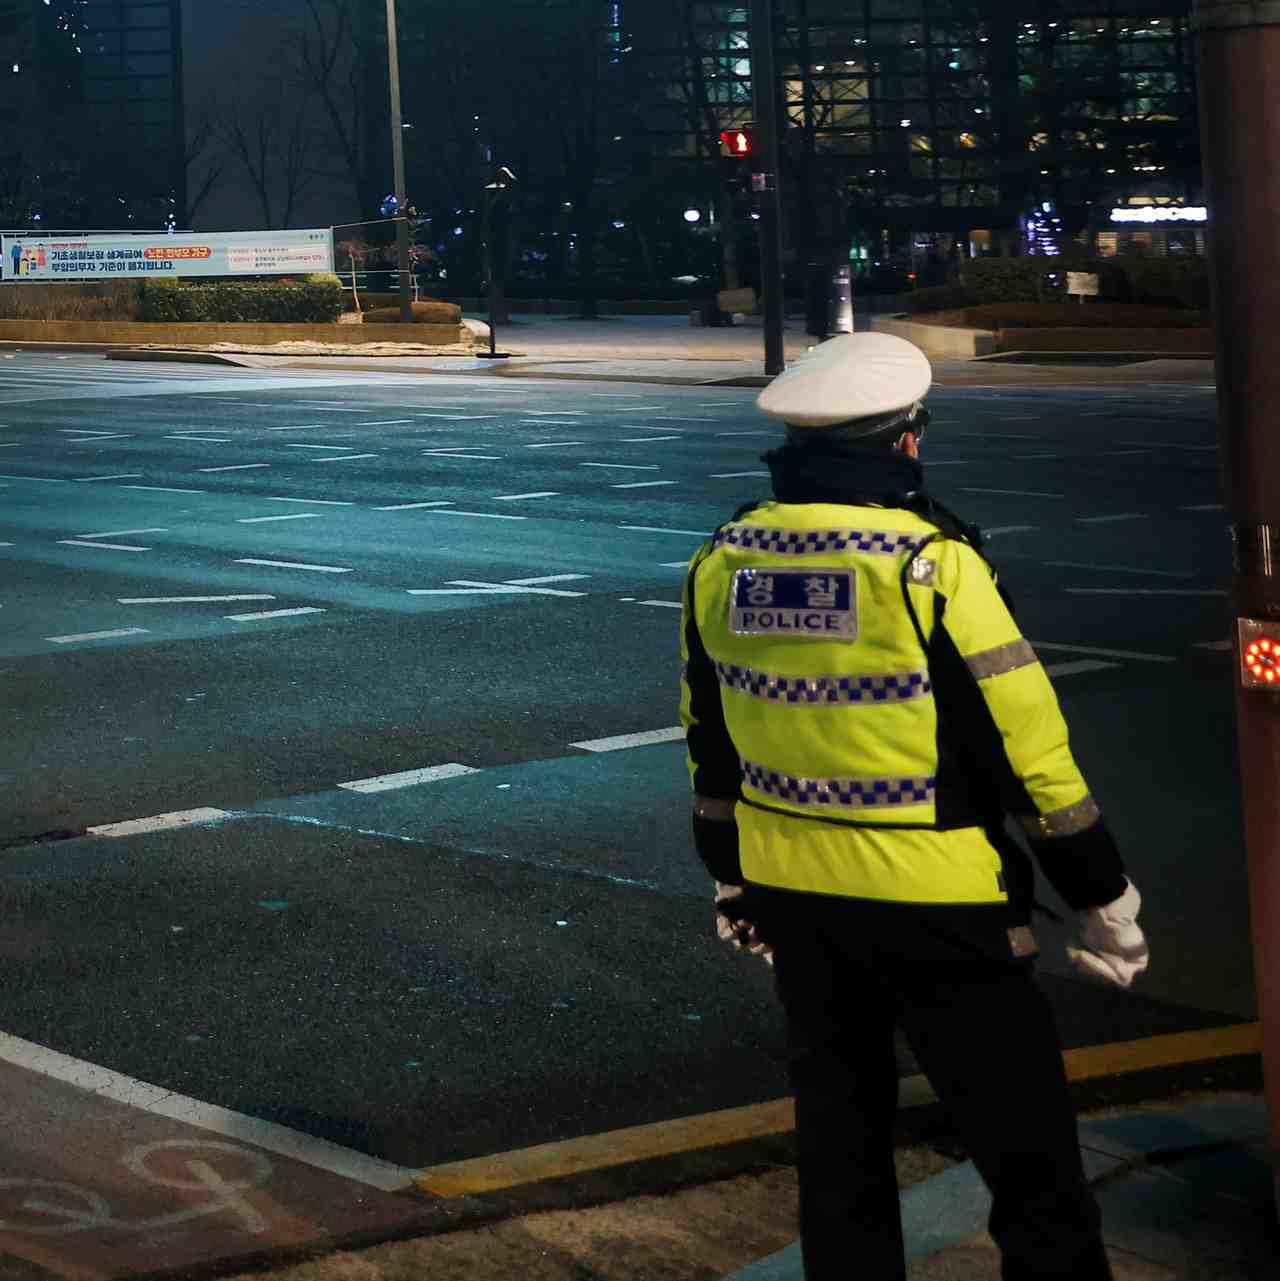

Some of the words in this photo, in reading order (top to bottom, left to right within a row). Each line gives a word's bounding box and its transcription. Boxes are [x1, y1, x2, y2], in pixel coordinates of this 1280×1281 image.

[98, 261, 126, 271] 기준이
[746, 575, 839, 607] 경찰
[742, 612, 840, 629] POLICE
